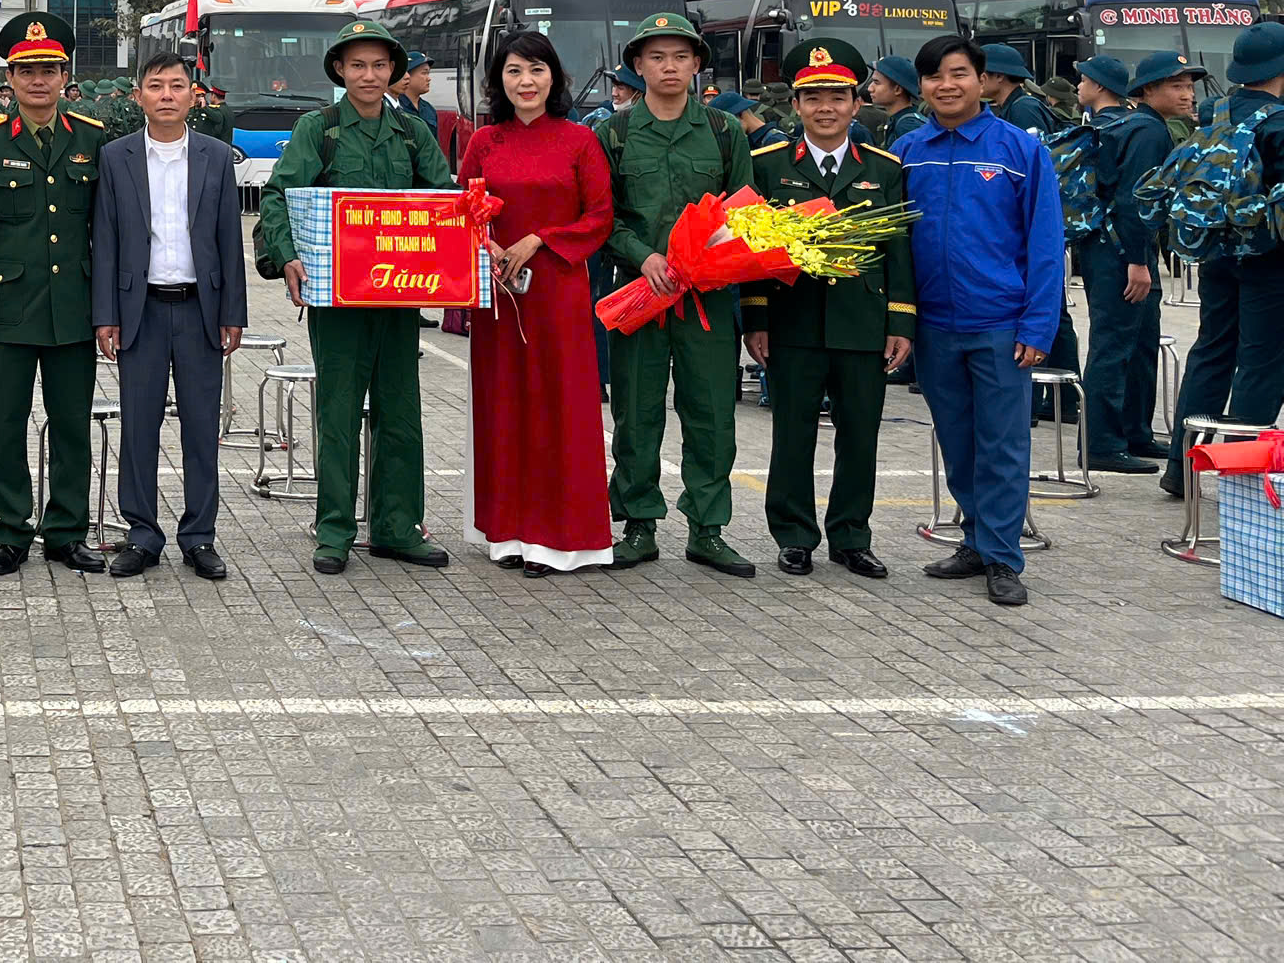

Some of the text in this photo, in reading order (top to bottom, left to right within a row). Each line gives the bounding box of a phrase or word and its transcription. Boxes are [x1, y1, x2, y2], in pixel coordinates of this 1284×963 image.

[810, 0, 842, 17] VIP
[884, 8, 948, 20] LIMOUSINE
[1121, 7, 1180, 25] MINH
[408, 210, 430, 227] UBND
[395, 236, 421, 252] THANH
[370, 263, 442, 294] Tặng
